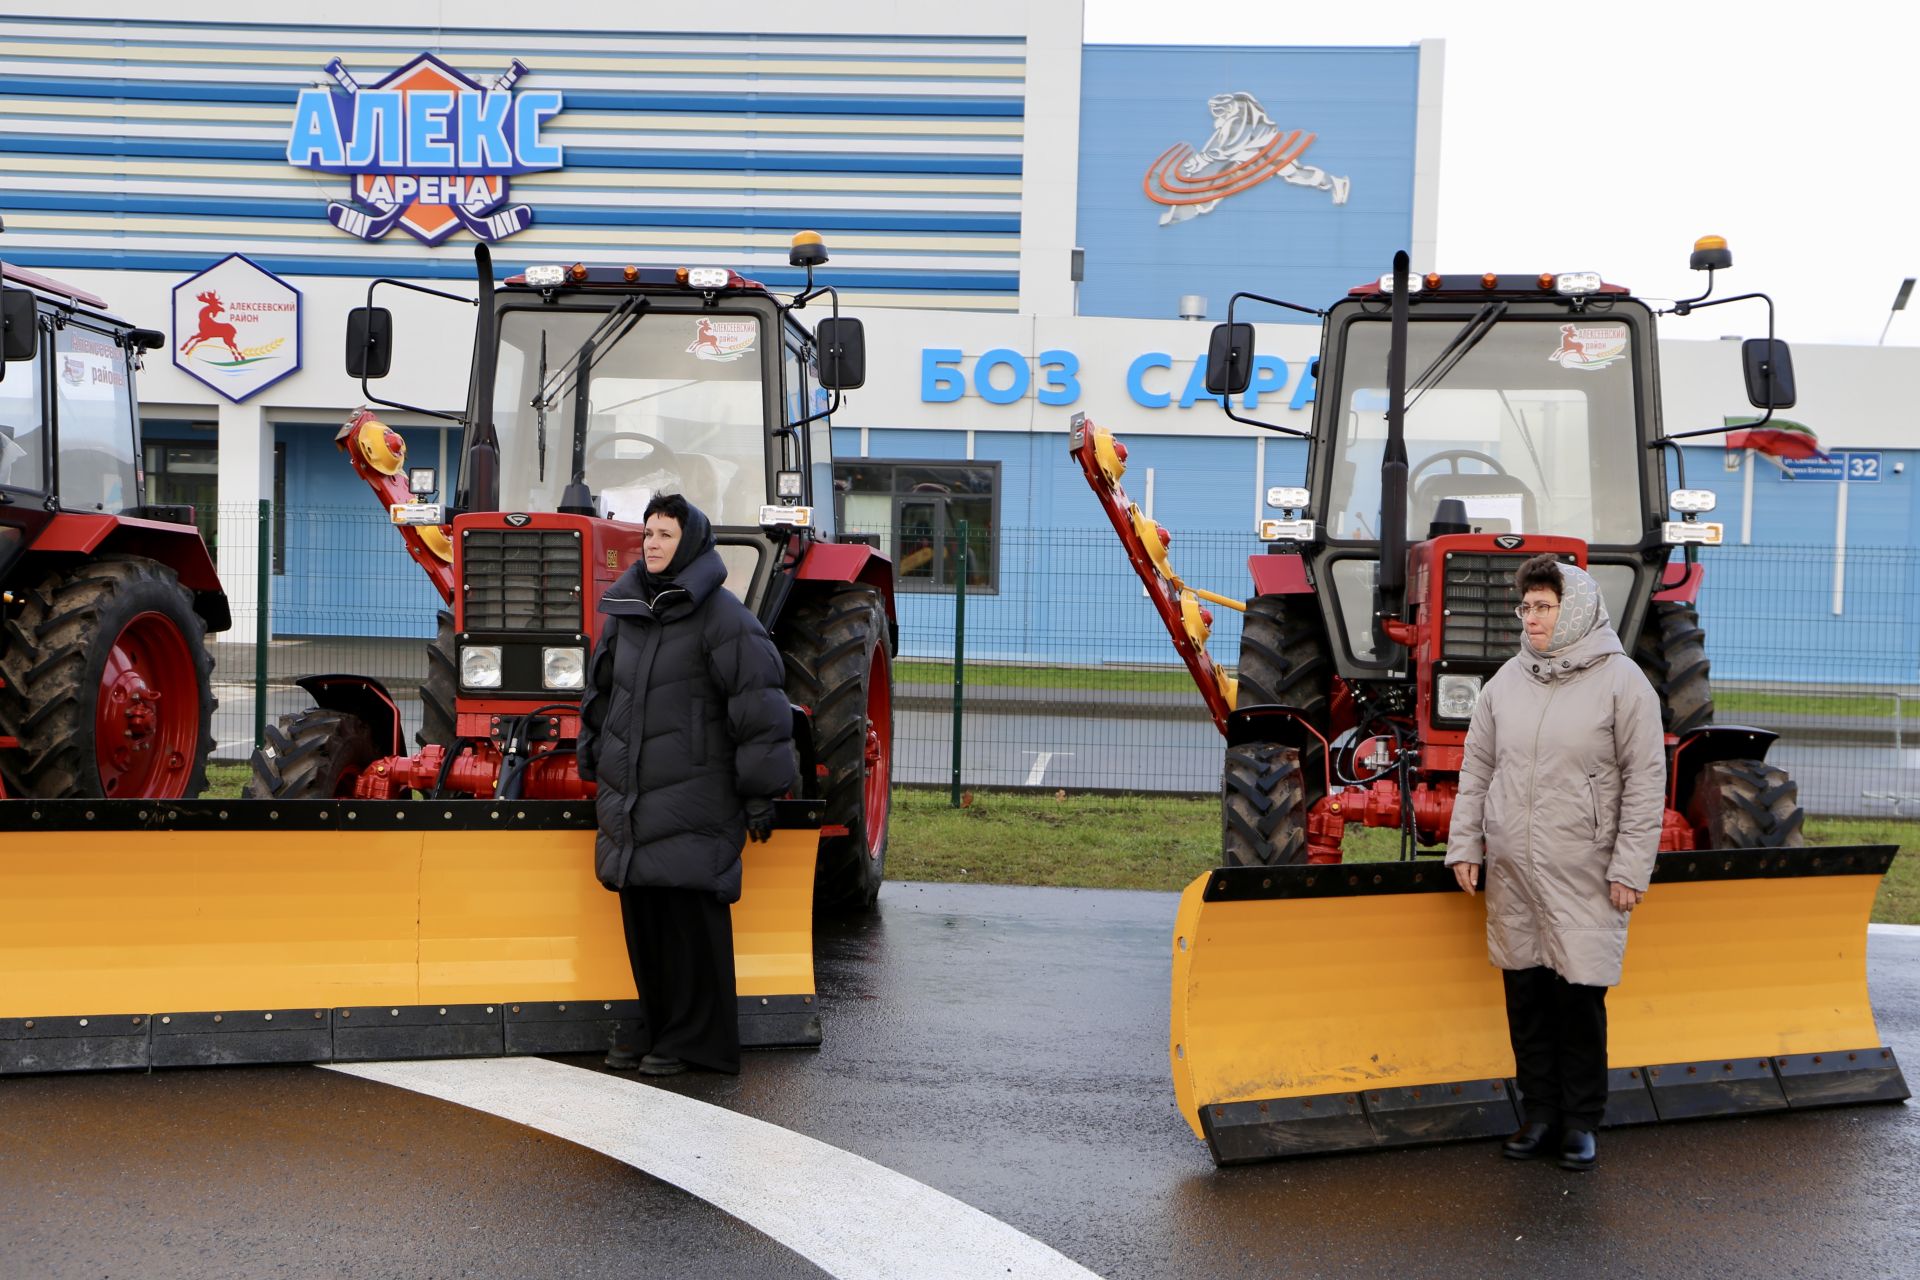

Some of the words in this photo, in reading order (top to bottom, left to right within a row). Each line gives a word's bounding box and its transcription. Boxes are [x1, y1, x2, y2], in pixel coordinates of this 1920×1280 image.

[286, 89, 563, 167] АЛЕКС
[366, 175, 494, 206] АРЕНА
[230, 301, 296, 311] АЛЕКСЕЕВСКИЙ
[230, 313, 259, 322] РАЙОН
[921, 348, 1081, 406] БОЗ
[1851, 458, 1878, 476] 32
